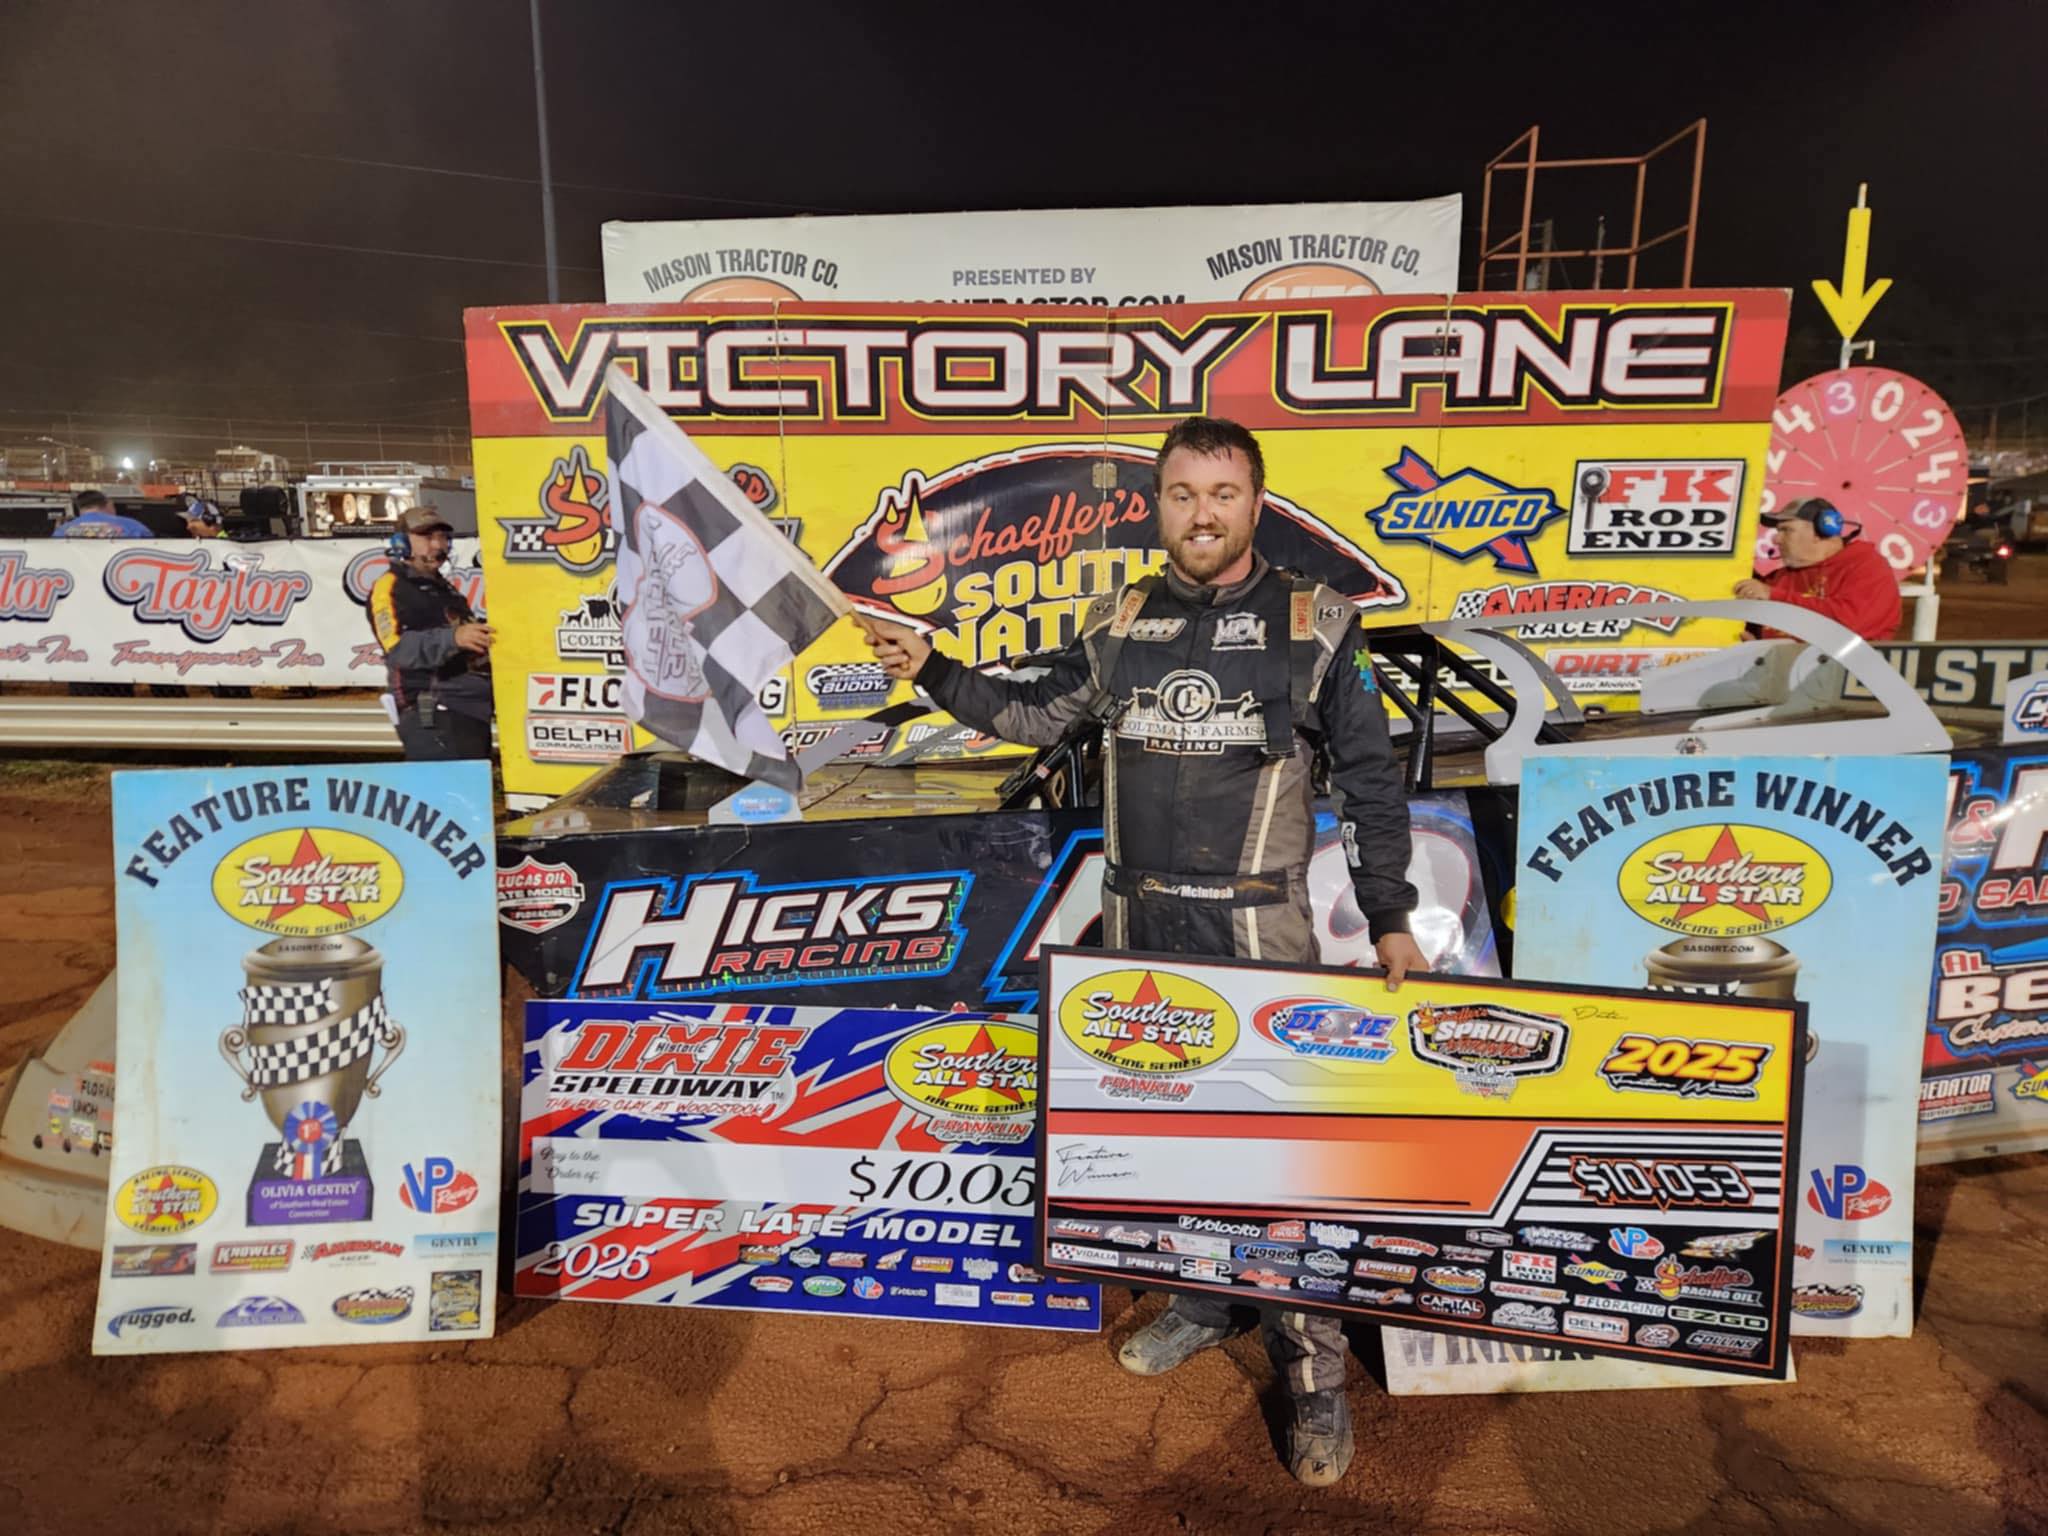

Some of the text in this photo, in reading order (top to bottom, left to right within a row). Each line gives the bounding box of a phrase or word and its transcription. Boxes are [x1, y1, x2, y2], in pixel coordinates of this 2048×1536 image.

[1206, 234, 1421, 280] MASON TRACTOR CO.
[643, 248, 839, 293] MASON TRACTOR CO.
[952, 266, 1097, 287] PRESENTED BY
[505, 308, 1724, 419] VICTORY LANE
[1608, 468, 1734, 503] FK
[1388, 497, 1540, 529] SUNOCO
[1609, 509, 1728, 527] ROD
[1582, 530, 1725, 548] ENDS
[116, 556, 306, 631] Taylor
[953, 546, 1168, 622] SOUTH
[1482, 584, 1686, 630] AMERICAN
[567, 634, 624, 648] COLTM
[1555, 653, 1650, 675] DIRT
[822, 680, 883, 694] BUDDY
[533, 726, 622, 743] DELPH
[1200, 723, 1260, 738] FARMS
[1149, 739, 1219, 751] RACING
[124, 777, 487, 889] FEATURE WINNER
[1526, 770, 1934, 887] FEATURE WINNER
[239, 856, 380, 889] Southern
[498, 872, 567, 888] LUCAS OIL
[1647, 851, 1805, 887] Southern
[241, 884, 380, 906] ALL STAR
[497, 887, 580, 900] ATE MODEL
[1181, 883, 1235, 900] McIntosh
[1645, 884, 1803, 905] ALL STAR
[254, 914, 367, 936] RACING SERIES
[583, 884, 952, 986] HICKS
[1659, 916, 1785, 936] RACING SERIES
[710, 935, 945, 974] RACING
[1937, 968, 2048, 1021] BE
[1083, 990, 1214, 1028] Southern
[1286, 1009, 1394, 1038] DIXIE
[1433, 1021, 1541, 1048] SPRING
[1083, 1022, 1214, 1048] ALL STAR
[557, 1022, 810, 1077] DIXIE
[655, 1041, 708, 1053] Historic
[1295, 1041, 1392, 1061] SPEEDWAY
[1093, 1048, 1202, 1071] RACING SERIES
[1604, 1035, 1767, 1084] 2025
[551, 1075, 774, 1098] SPEEDWAY
[914, 1071, 967, 1085] ALL
[1099, 1075, 1194, 1097] FRANKLIN
[1920, 1073, 1992, 1100] REDATOR
[546, 1098, 574, 1109] THE
[576, 1098, 611, 1110] RED
[613, 1100, 650, 1112] CLAY
[652, 1101, 671, 1112] AT
[924, 1094, 979, 1113] RACING
[931, 1119, 1032, 1137] FRANKLIN
[582, 1150, 601, 1161] the
[1056, 1142, 1131, 1165] Feature
[261, 1181, 360, 1198] OLIVIA GENTRY
[404, 1156, 453, 1214] VP
[849, 1154, 1036, 1208] $10,05
[1573, 1158, 1751, 1205] $10,053
[1810, 1164, 1867, 1221] VP
[573, 1202, 725, 1233] SUPER
[739, 1209, 850, 1238] LATE
[863, 1216, 1023, 1248] MODEL
[313, 1240, 405, 1260] AMERICAN
[431, 1236, 479, 1249] GENTRY
[1609, 1226, 1649, 1257] VP
[1842, 1244, 1892, 1255] GENTRY
[217, 1243, 288, 1263] KNOWLES
[534, 1240, 658, 1282] 2025
[1076, 1249, 1118, 1261] VIDALIA
[1567, 1264, 1626, 1281] SUNOCO
[1420, 1294, 1481, 1312] CAPITAL
[1680, 1285, 1755, 1303] RACING OIL
[1587, 1297, 1666, 1317] FLORACING
[118, 1309, 196, 1328] rugged.
[1568, 1317, 1624, 1332] DELPH
[1688, 1333, 1758, 1349] COLLINS
